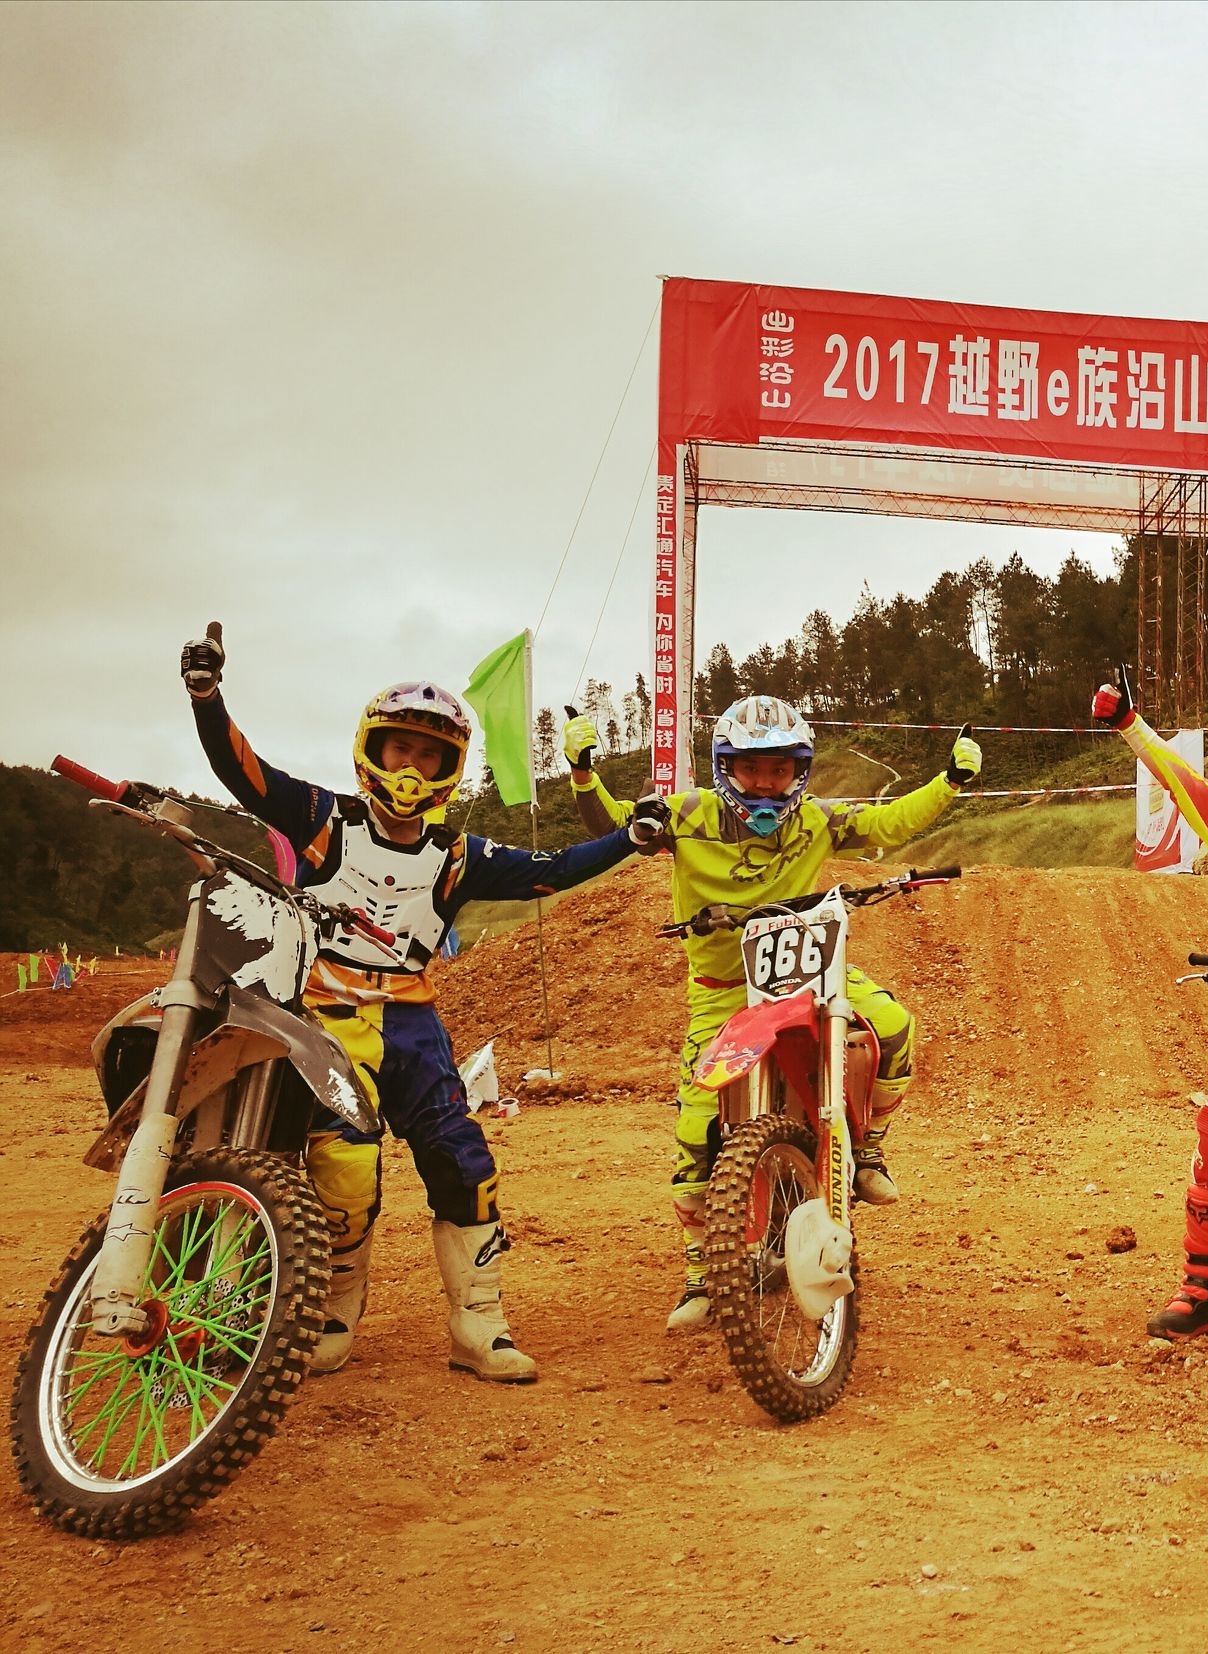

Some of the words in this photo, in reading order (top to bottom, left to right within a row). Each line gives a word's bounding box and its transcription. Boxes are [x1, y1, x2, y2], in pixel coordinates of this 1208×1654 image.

[655, 474, 674, 598] 贵定汇通汽车
[655, 613, 673, 695] 为你省时
[656, 708, 674, 748] 省钱
[755, 925, 827, 987] 666
[768, 977, 802, 989] HONDA
[831, 1135, 843, 1222] DUNLOP
